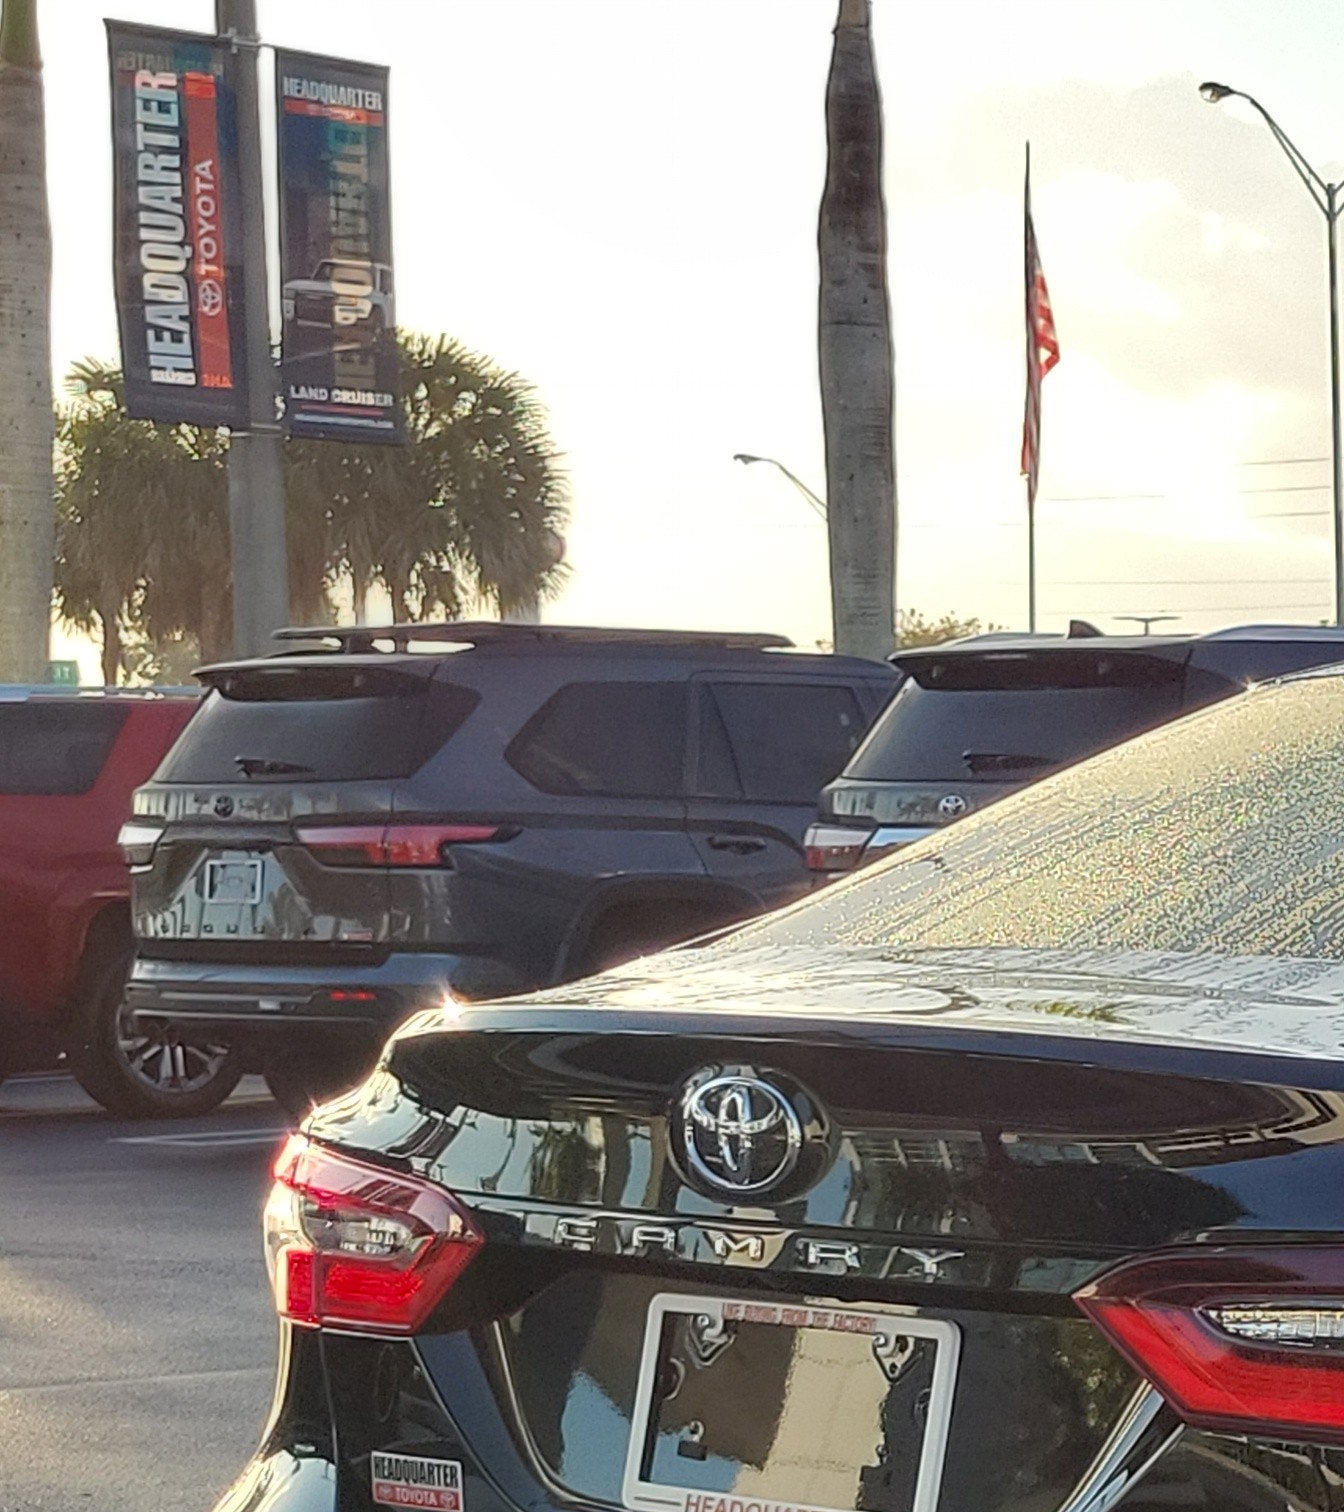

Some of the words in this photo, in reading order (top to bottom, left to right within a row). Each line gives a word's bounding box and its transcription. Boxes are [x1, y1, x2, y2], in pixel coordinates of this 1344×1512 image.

[283, 76, 383, 111] HEADQUARTER
[134, 69, 197, 386] HEADQUARTER
[194, 159, 219, 274] TOYOTA
[289, 384, 329, 401] LAND
[330, 387, 394, 407] CRUISER
[554, 1215, 966, 1282] CAMRY
[373, 1455, 460, 1489] HEADQUARTER
[395, 1487, 438, 1506] TOYOTA
